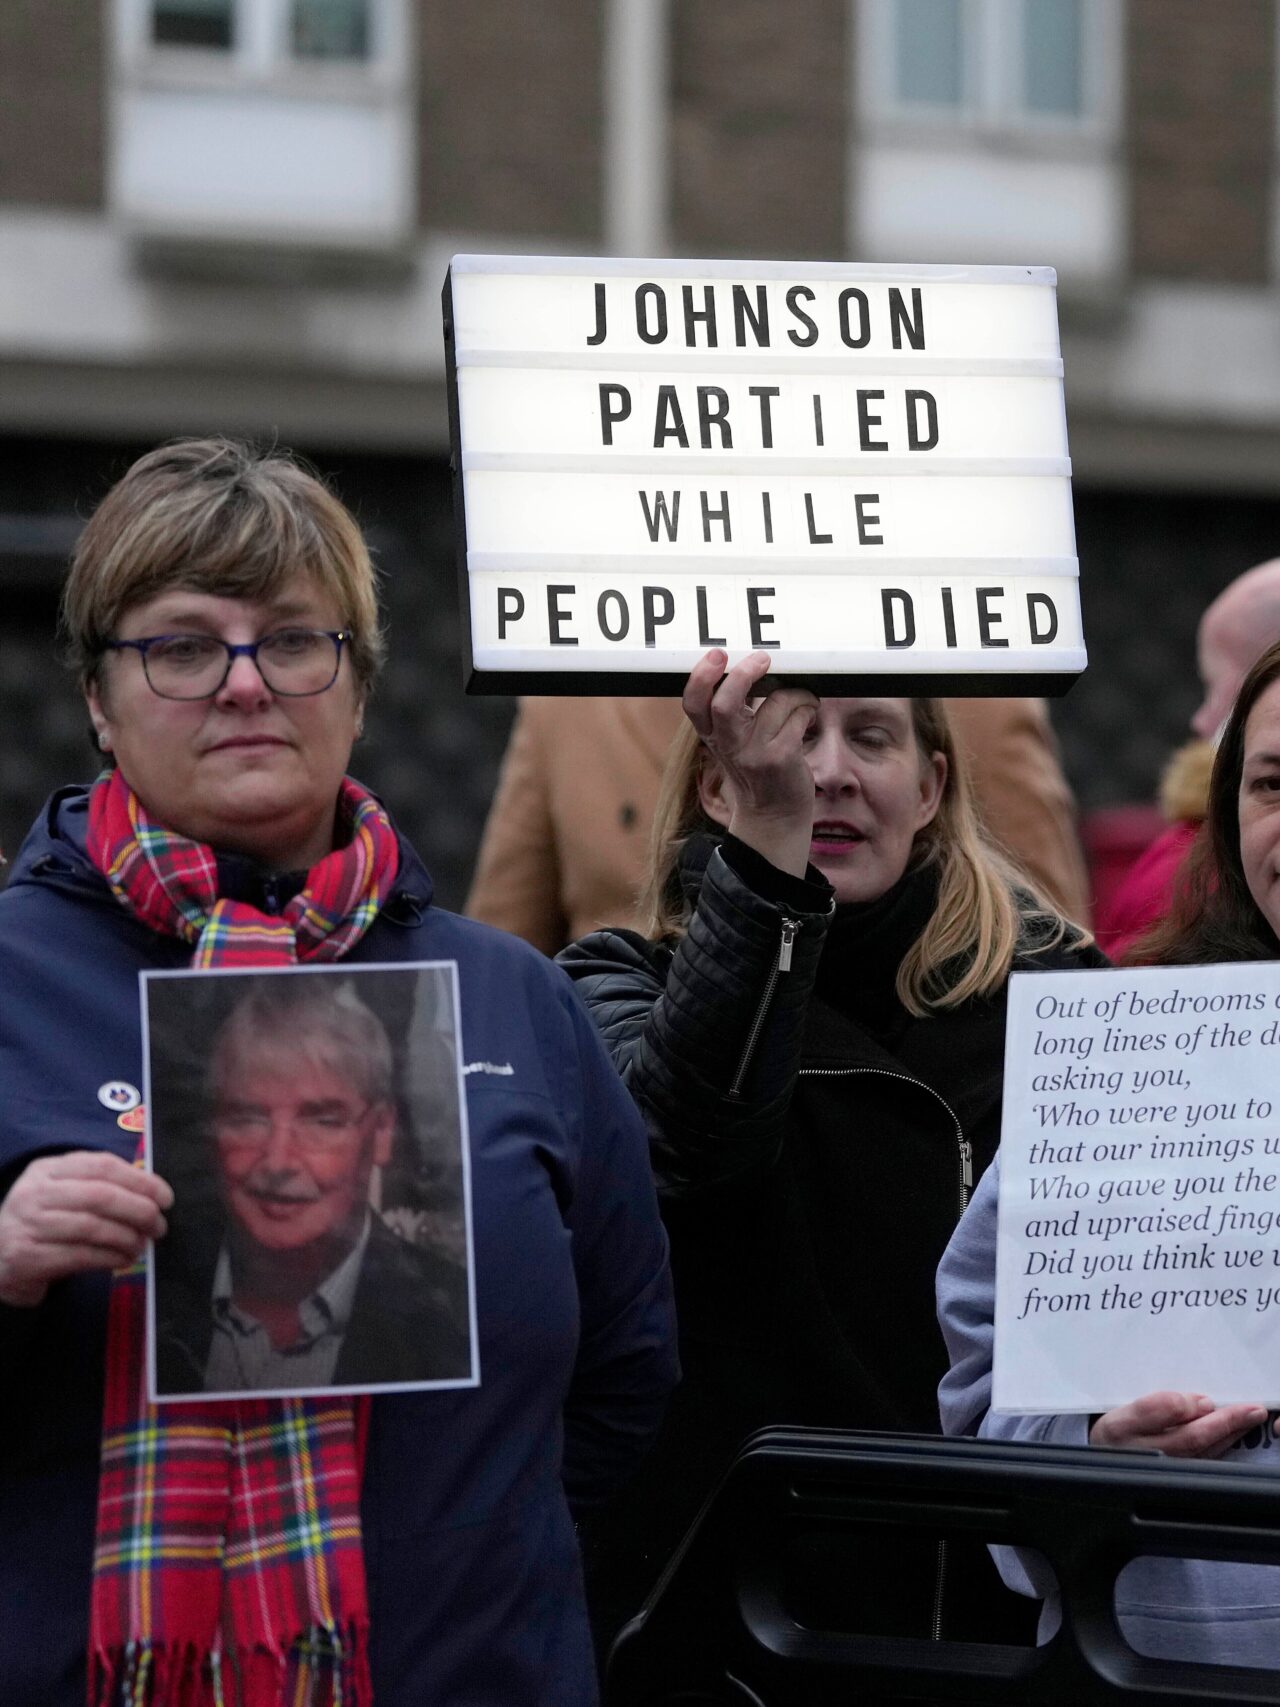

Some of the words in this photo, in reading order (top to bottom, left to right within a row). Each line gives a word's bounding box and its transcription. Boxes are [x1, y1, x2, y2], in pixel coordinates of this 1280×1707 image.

[586, 282, 926, 351] JOHNSON
[598, 383, 939, 452] PARTIED
[638, 490, 884, 546] WHILE
[497, 584, 781, 650] PEOPLE
[880, 586, 1059, 650] DIED
[1035, 995, 1088, 1020] Out
[1094, 991, 1127, 1023] of
[1128, 989, 1267, 1016] bedrooms
[1033, 1030, 1094, 1061] long
[1103, 1027, 1167, 1053] lines
[1174, 1023, 1208, 1055] of
[1210, 1022, 1252, 1048] the
[1031, 1065, 1124, 1095] asking
[1131, 1069, 1191, 1094] you,
[1032, 1101, 1100, 1128] ‘Who
[1109, 1105, 1178, 1125] were
[1184, 1103, 1237, 1128] you
[1245, 1097, 1273, 1119] to
[1028, 1139, 1087, 1165] that
[1092, 1143, 1143, 1162] our
[1150, 1132, 1255, 1163] innings
[1029, 1174, 1090, 1200] Who
[1097, 1179, 1166, 1205] gave
[1172, 1176, 1225, 1202] you
[1234, 1166, 1277, 1193] the
[1024, 1209, 1080, 1238] and
[1087, 1205, 1212, 1242] upraised
[1023, 1248, 1076, 1276] Did
[1081, 1254, 1133, 1280] you
[1142, 1242, 1216, 1271] think
[1223, 1249, 1264, 1269] we
[1016, 1287, 1091, 1320] from
[1100, 1283, 1143, 1310] the
[1149, 1288, 1248, 1315] graves
